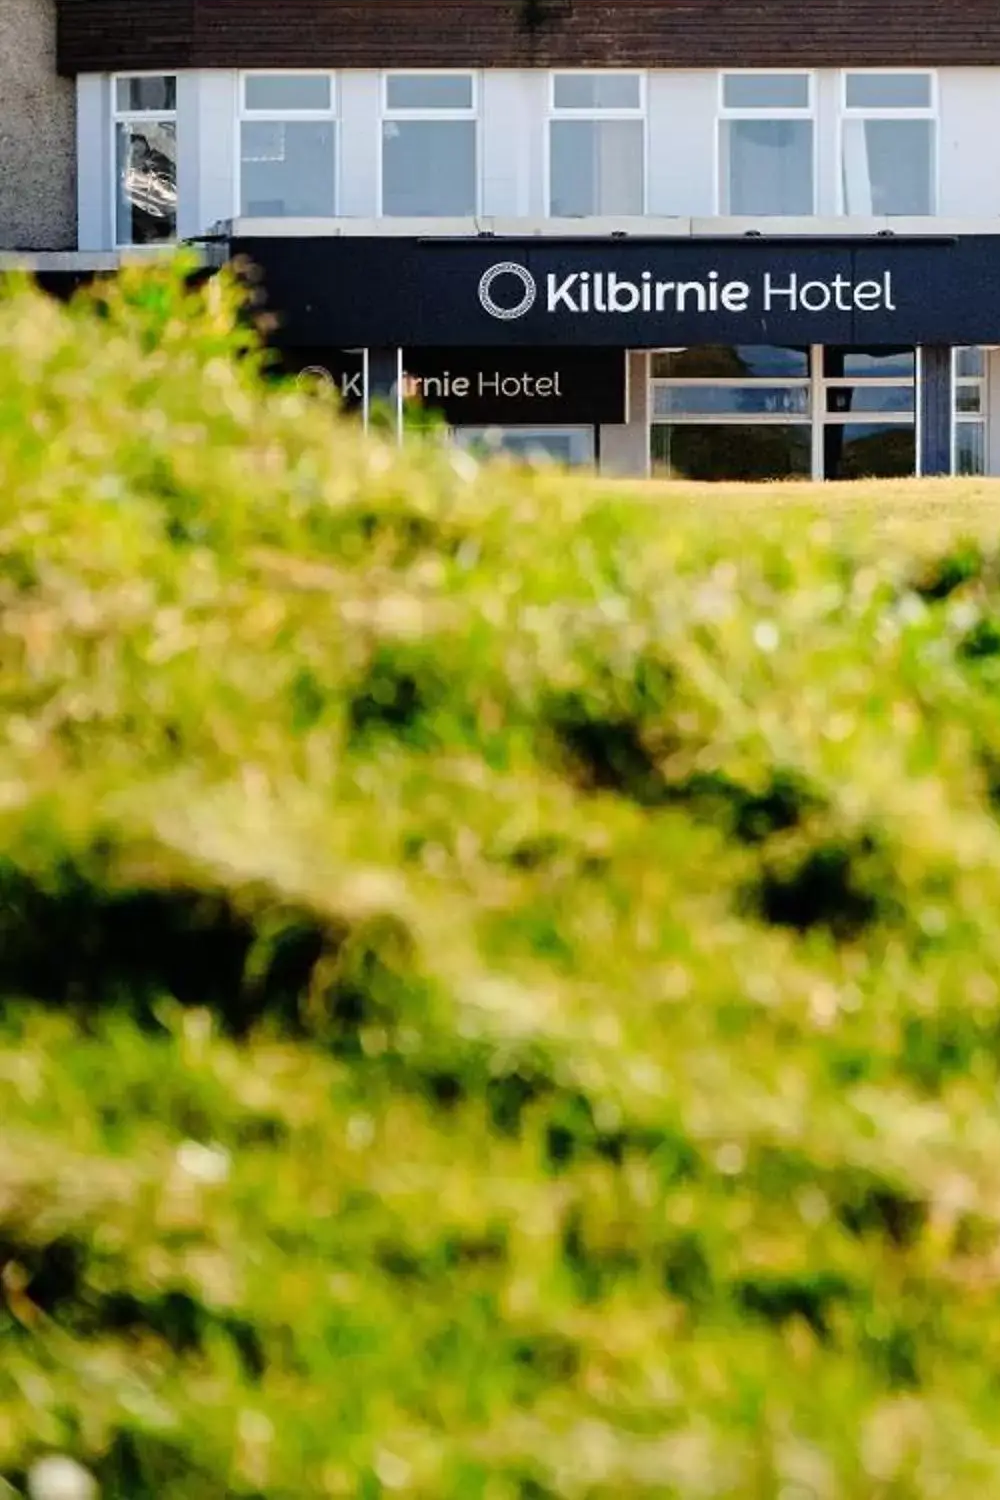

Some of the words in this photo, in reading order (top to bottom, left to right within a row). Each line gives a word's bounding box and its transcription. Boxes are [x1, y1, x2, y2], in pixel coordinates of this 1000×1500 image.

[547, 271, 750, 312] Kilbirnie
[763, 270, 896, 312] Hotel
[341, 370, 470, 397] Kirnie
[477, 371, 562, 397] Hotel
